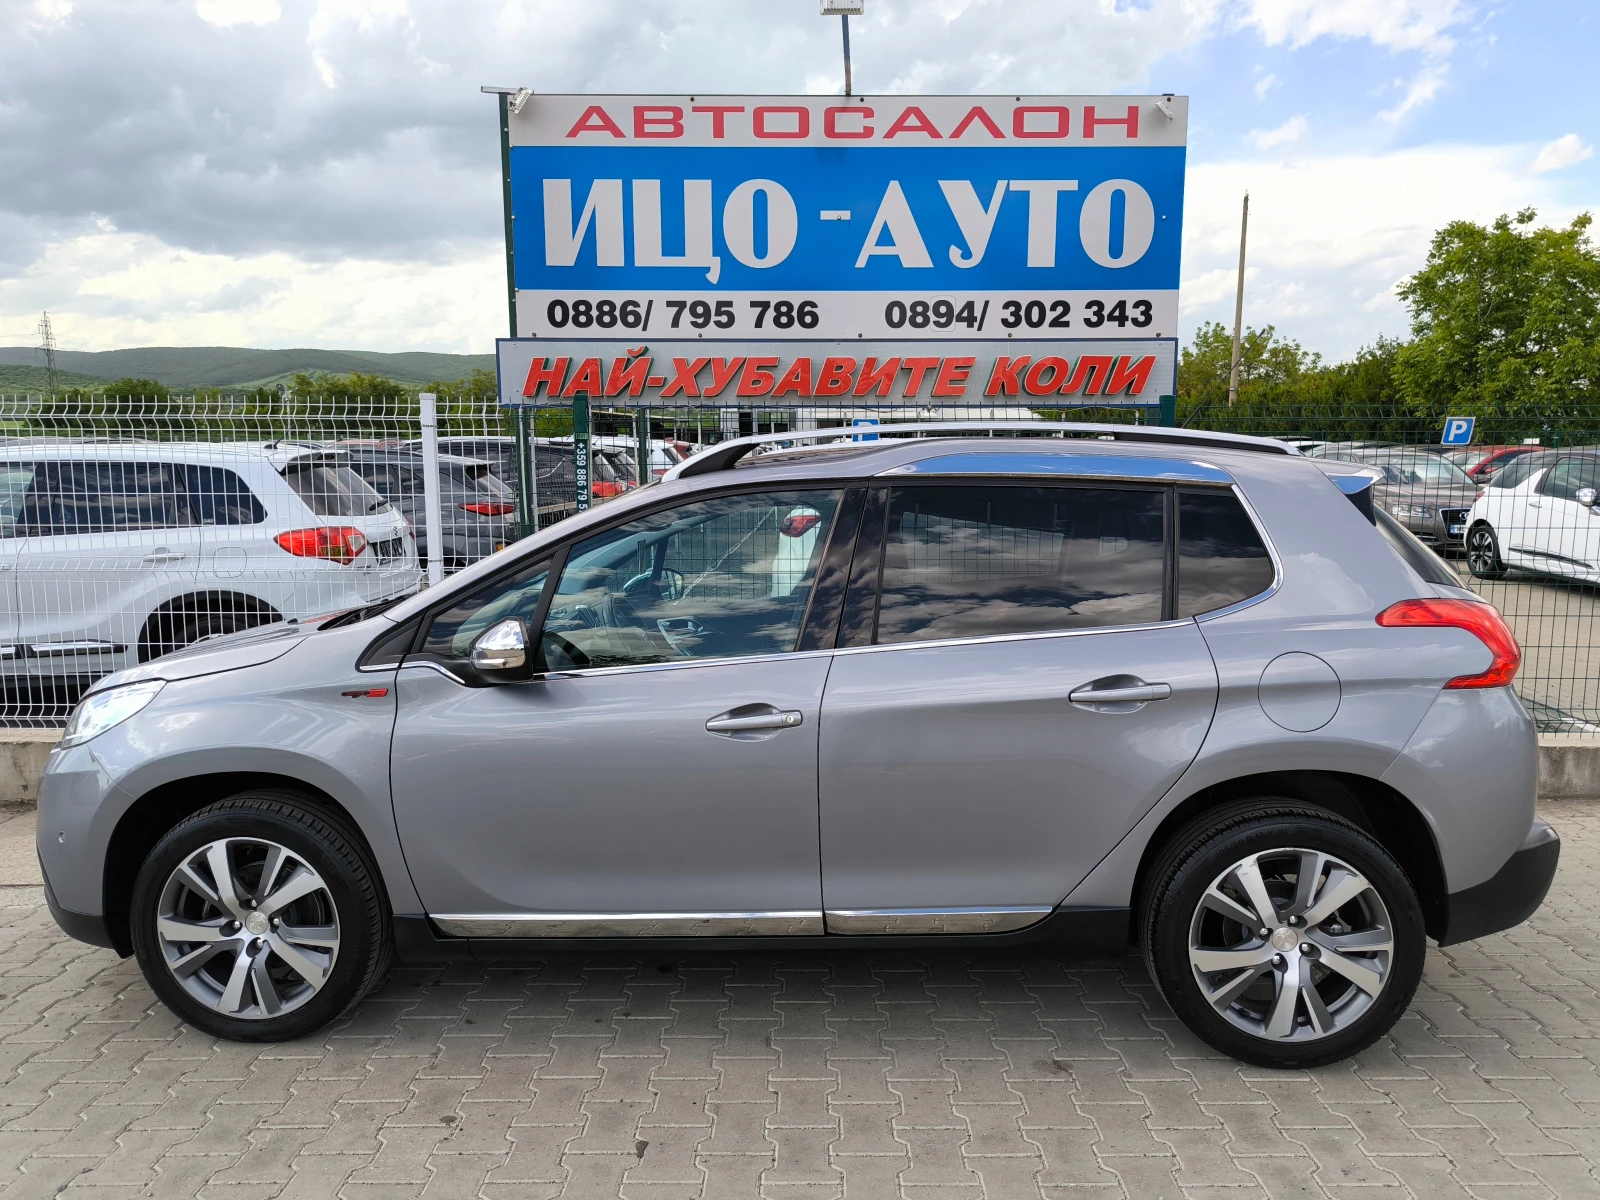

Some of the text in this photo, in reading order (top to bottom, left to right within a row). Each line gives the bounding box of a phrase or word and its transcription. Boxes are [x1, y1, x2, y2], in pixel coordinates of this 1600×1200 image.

[565, 105, 1139, 139] АВТОСАЛОН
[547, 299, 819, 331] 0886/ 795 786
[884, 299, 1153, 331] 0894/ 302 343
[521, 345, 1157, 398] НАЙ-ХУБАВИТЕ КОЛИ
[1448, 420, 1468, 442] P
[576, 442, 588, 513] +359 886 79 5
